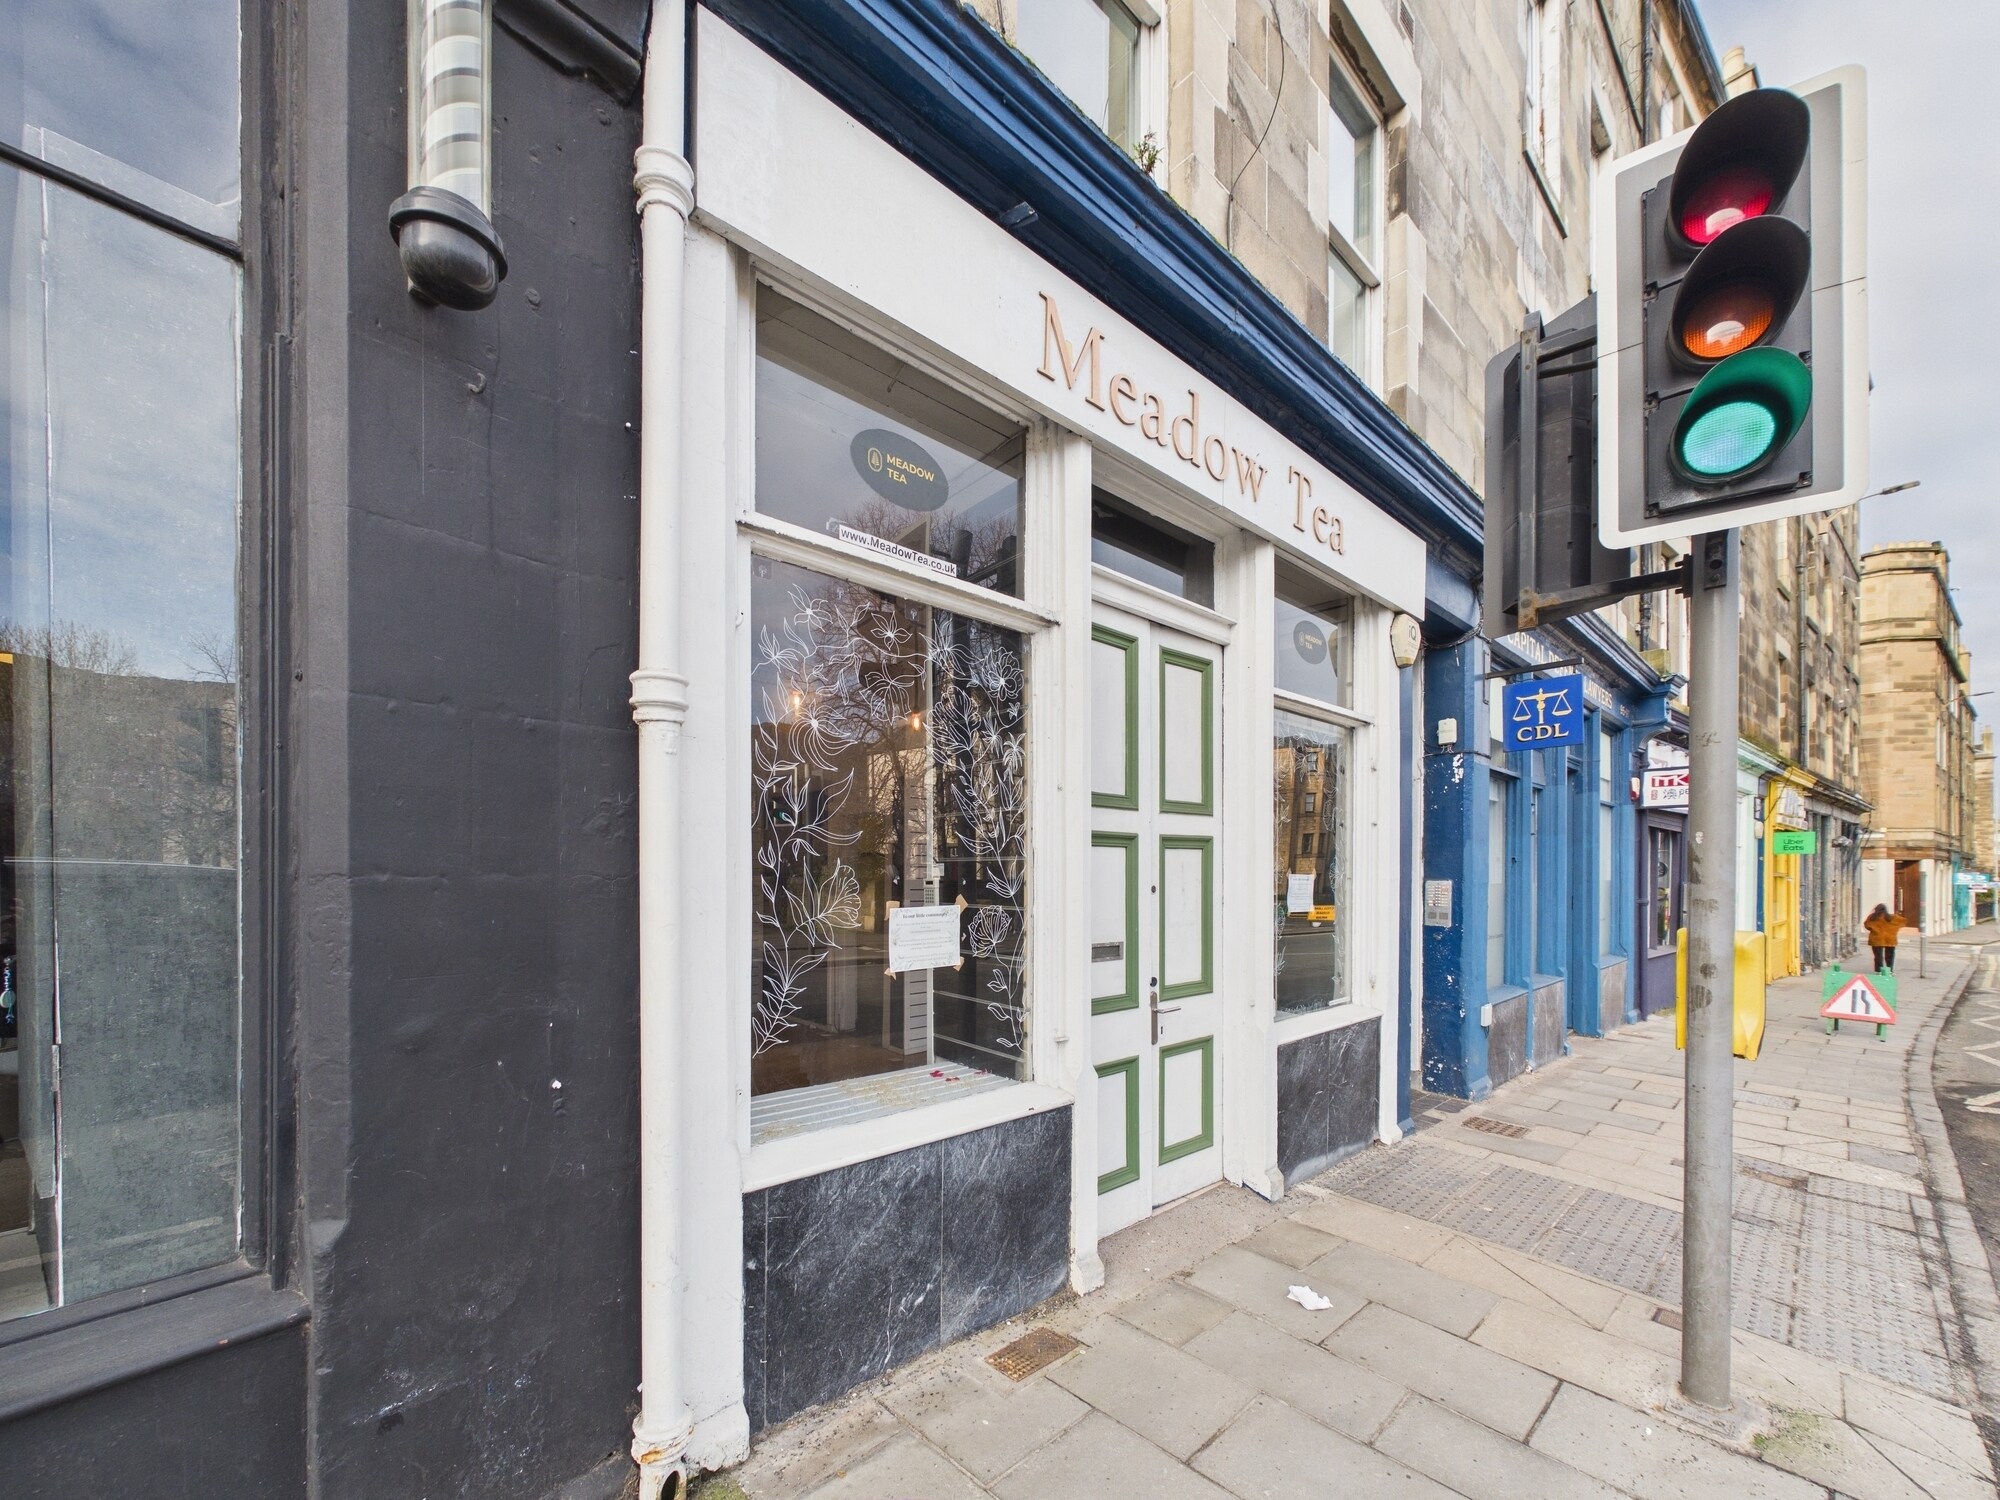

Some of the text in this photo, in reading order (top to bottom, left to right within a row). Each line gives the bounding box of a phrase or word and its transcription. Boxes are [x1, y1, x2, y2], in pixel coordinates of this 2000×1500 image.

[1036, 291, 1345, 555] Meadow Tea
[886, 454, 935, 482] MEADOW
[887, 468, 907, 485] TEA
[841, 528, 956, 575] www.MeadowTea.co.uk
[1517, 723, 1569, 741] CDL
